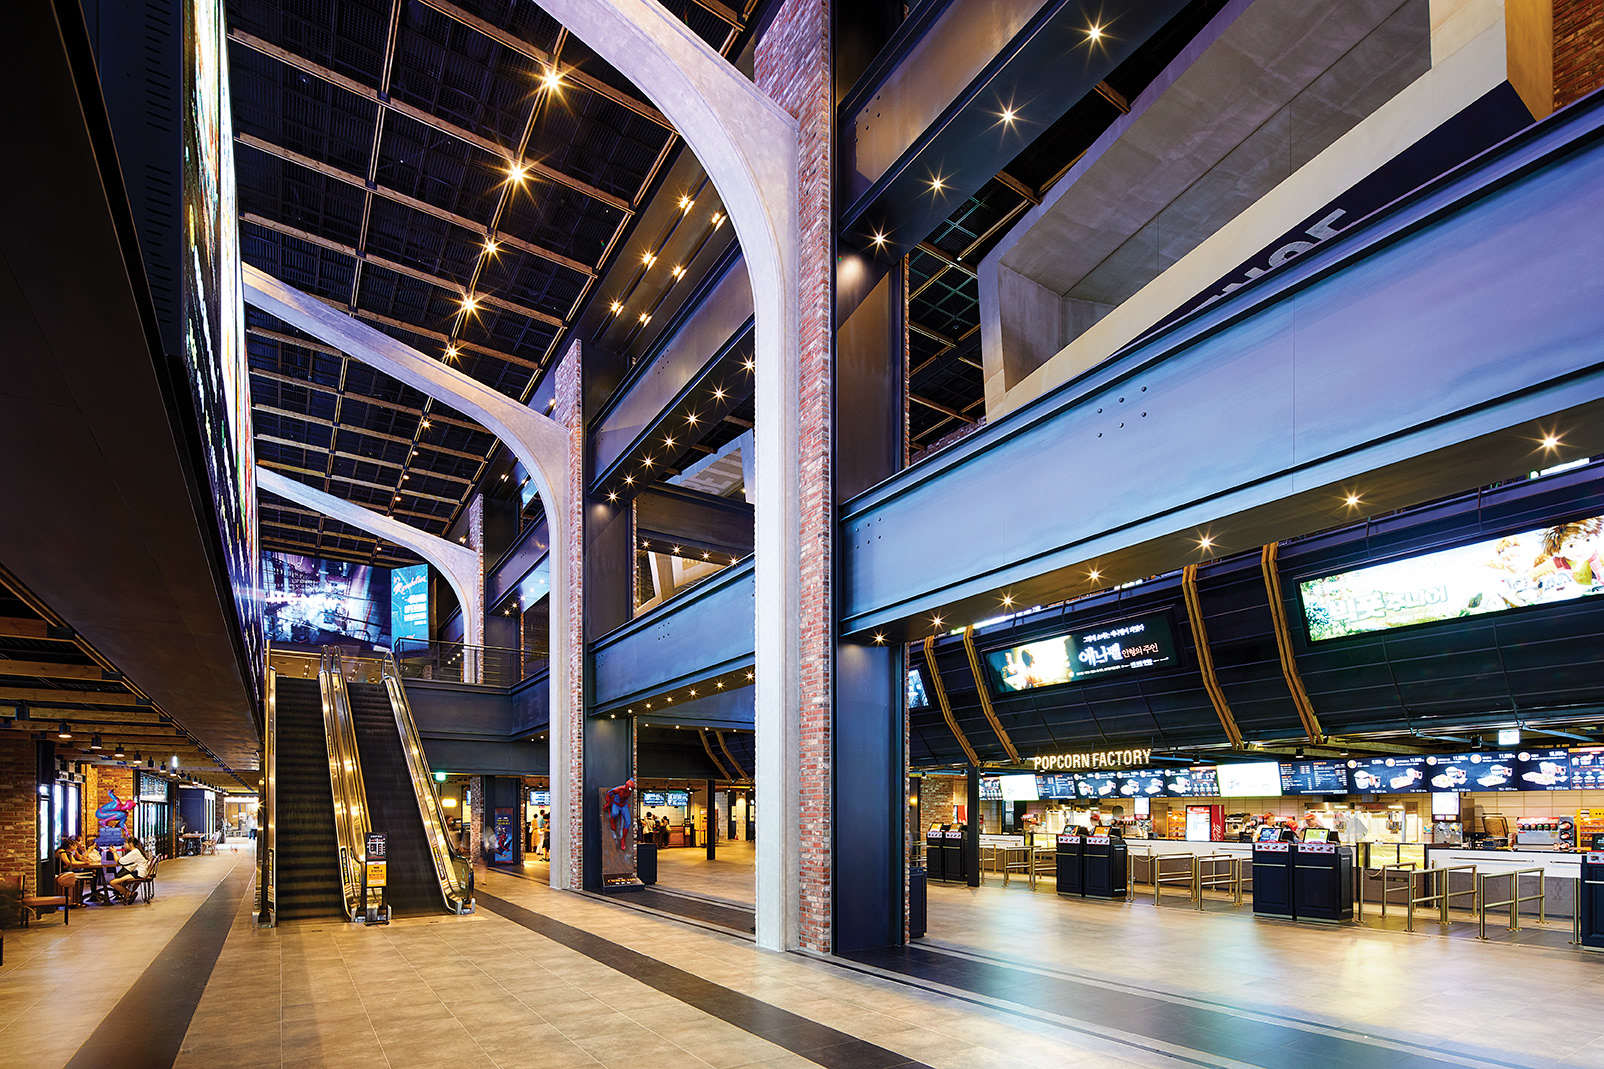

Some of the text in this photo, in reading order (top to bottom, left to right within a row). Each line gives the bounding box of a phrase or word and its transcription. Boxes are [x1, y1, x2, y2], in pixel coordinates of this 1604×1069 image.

[1385, 584, 1448, 612] 주니어
[1078, 642, 1123, 667] 애나벨
[1122, 646, 1143, 658] 인형의
[1143, 643, 1159, 654] 주인
[1034, 748, 1152, 770] POPCORN FACTORY
